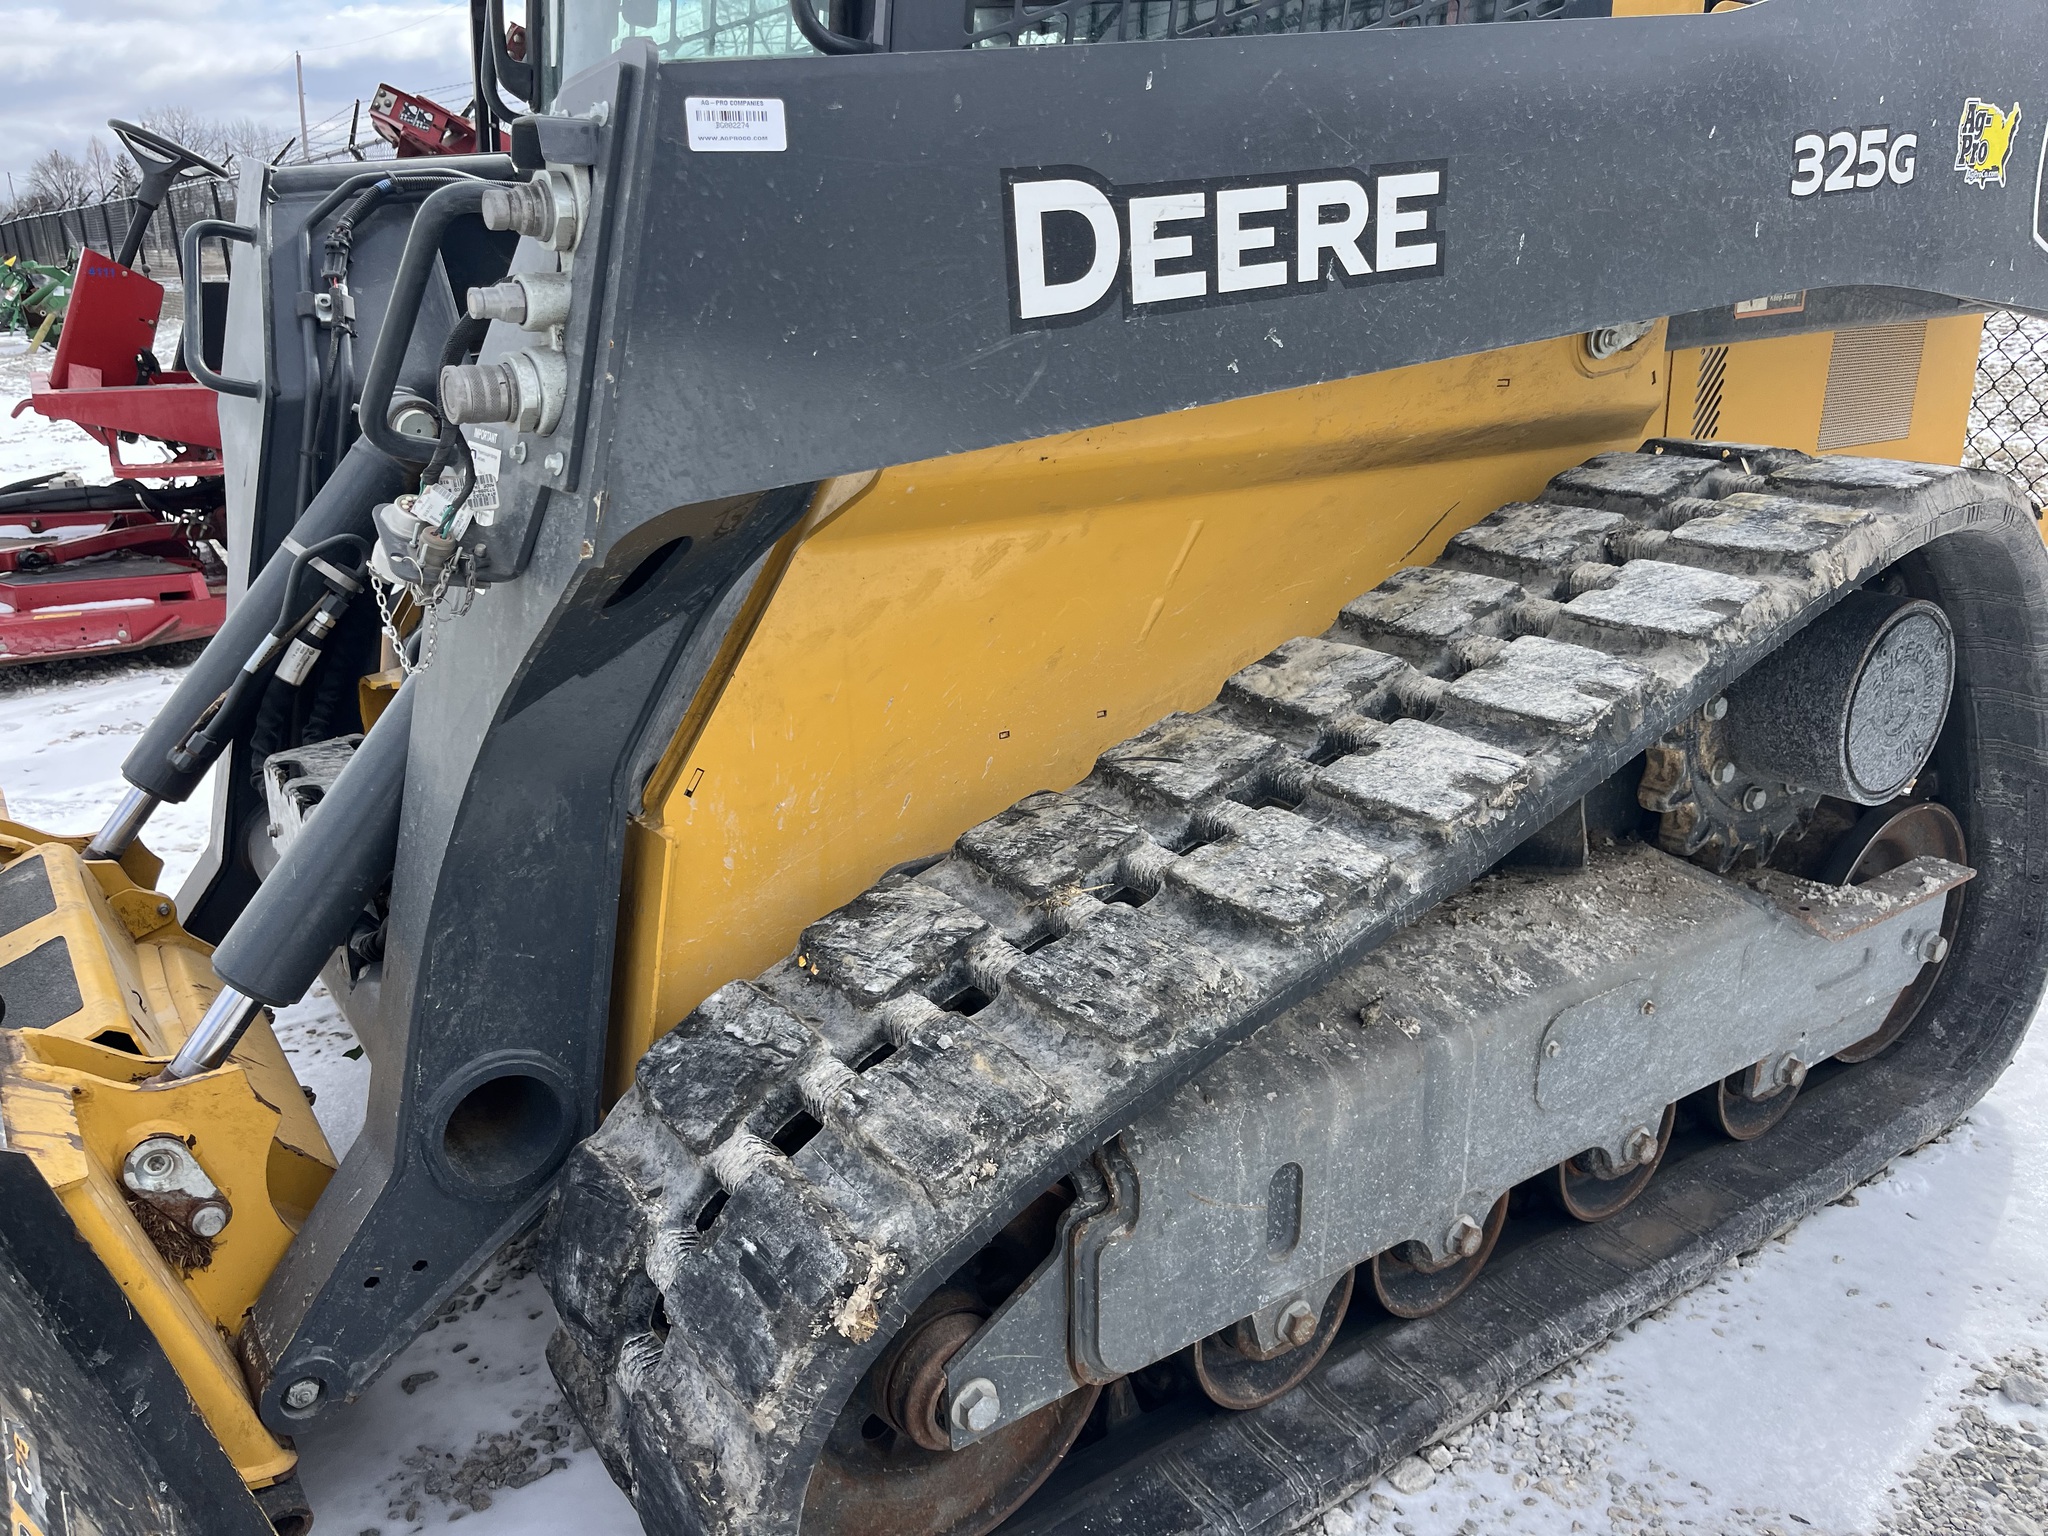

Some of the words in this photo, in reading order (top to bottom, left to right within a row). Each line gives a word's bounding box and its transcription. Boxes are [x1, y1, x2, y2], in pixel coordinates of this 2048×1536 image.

[1790, 128, 1918, 196] 325G
[1958, 135, 1988, 165] Pro
[1013, 171, 1440, 320] DEERE
[474, 428, 498, 444] IMPORTANT
